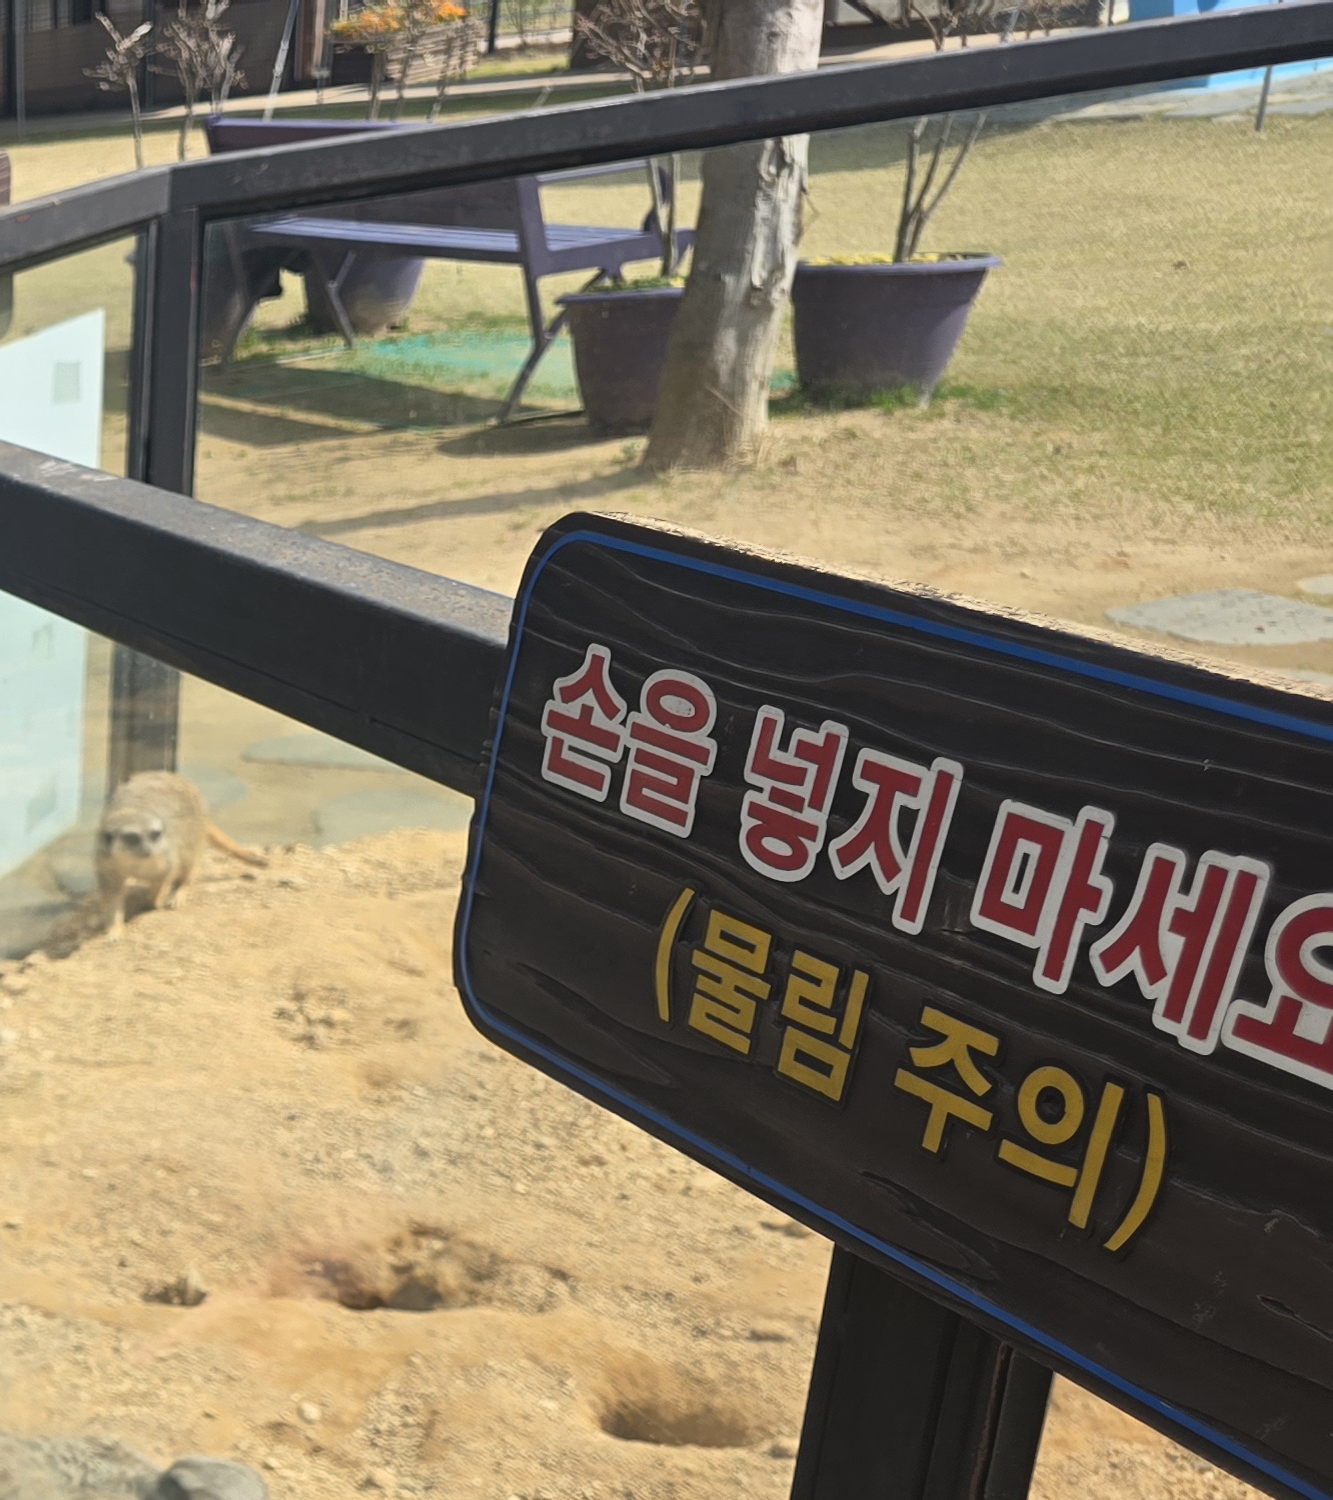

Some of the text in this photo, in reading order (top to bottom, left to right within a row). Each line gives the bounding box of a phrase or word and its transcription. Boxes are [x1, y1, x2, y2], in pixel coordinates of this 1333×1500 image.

[542, 644, 717, 837] 손을
[739, 705, 963, 934] 넣지
[657, 888, 1166, 1251] (물림 주의)
